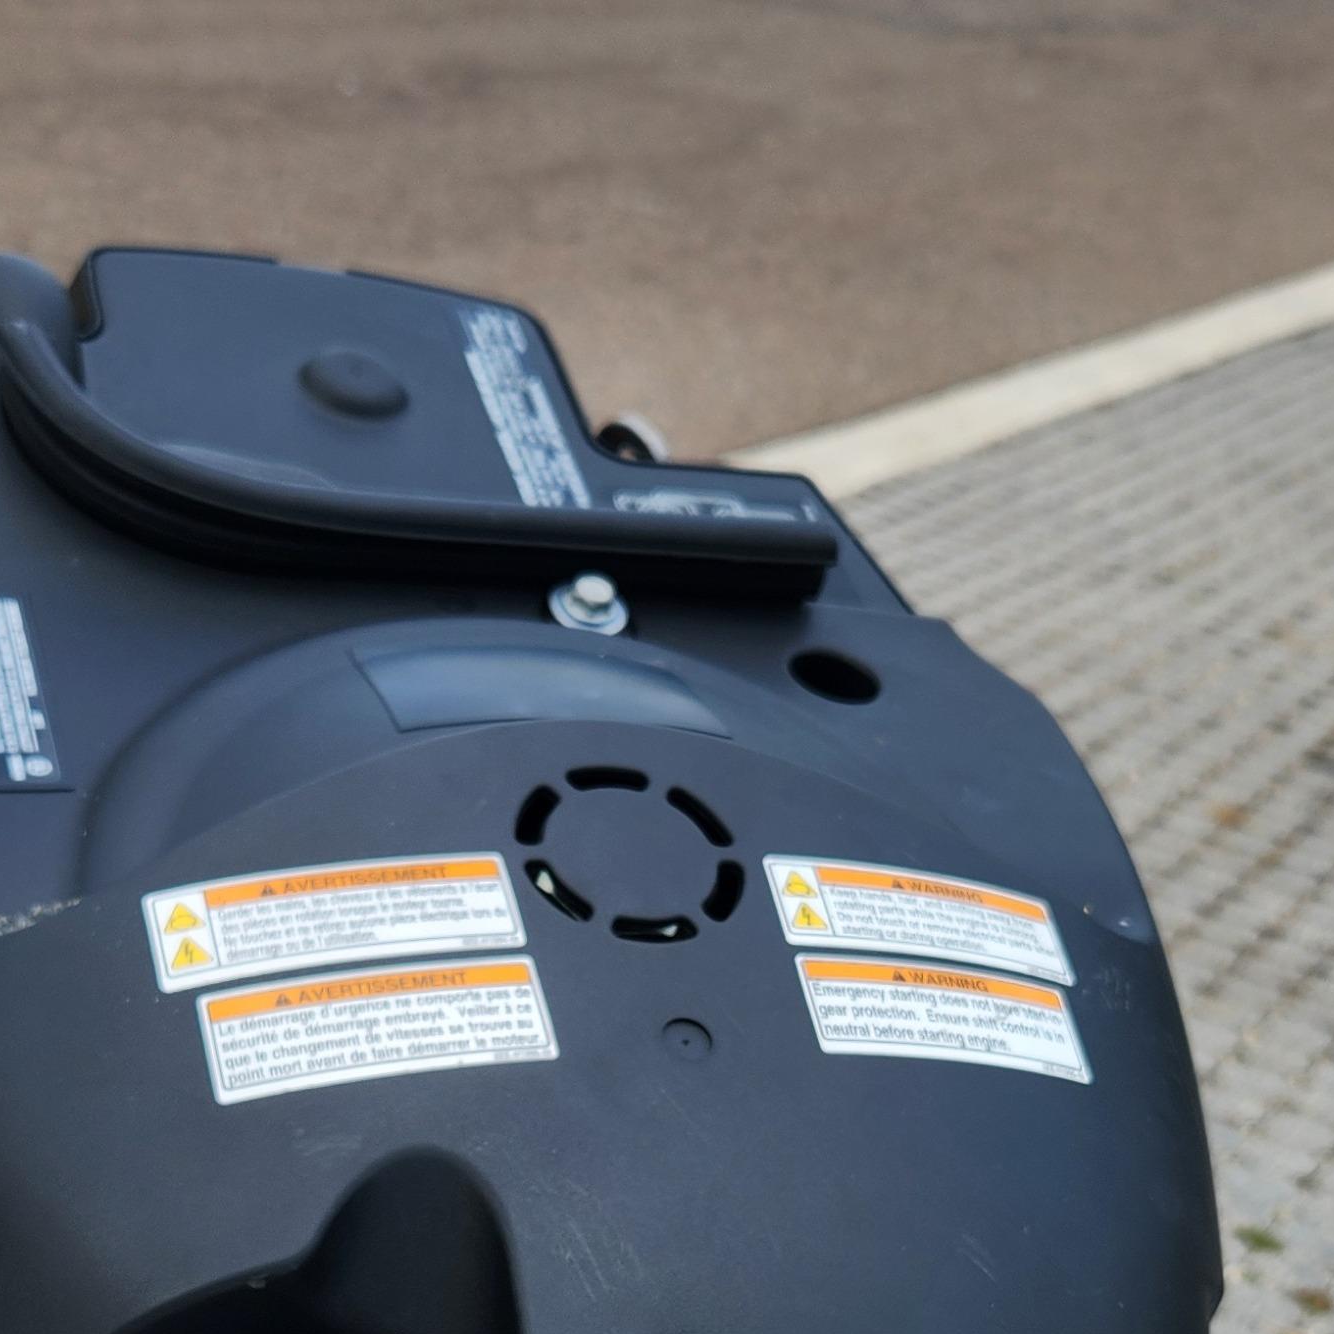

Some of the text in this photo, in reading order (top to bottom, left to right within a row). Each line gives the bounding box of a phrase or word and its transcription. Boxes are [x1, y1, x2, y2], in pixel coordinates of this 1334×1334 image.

[283, 864, 446, 894] AVERTISSEMENT
[906, 880, 984, 904] WARNING
[299, 973, 467, 1004] AVERTISSEMENT
[908, 970, 989, 993] WARNING
[219, 1021, 237, 1037] Le
[240, 1008, 316, 1033] démarrage
[395, 997, 411, 1009] ne
[417, 988, 482, 1007] comporte
[486, 989, 511, 1002] pas
[515, 986, 531, 999] de
[812, 982, 885, 1002] Emergency
[888, 987, 938, 1007] starting
[938, 992, 969, 1009] does
[970, 998, 992, 1012] not
[221, 1030, 279, 1051] sécurité
[283, 1026, 300, 1042] de
[305, 1015, 380, 1038] démarrage
[517, 1003, 532, 1014] ce
[818, 1004, 847, 1019] gear
[851, 1005, 921, 1022] protection.
[925, 1008, 969, 1026] Ensure
[972, 1014, 999, 1031] shift
[225, 1055, 251, 1070] que
[255, 1049, 268, 1063] le
[272, 1033, 361, 1060] changement
[365, 1030, 382, 1045] de
[386, 1024, 444, 1041] vitesses
[449, 1023, 464, 1035] se
[468, 1018, 513, 1033] trouve
[824, 1022, 871, 1038] neutral
[872, 1023, 915, 1040] before
[917, 1027, 967, 1050] starting
[228, 1064, 265, 1089] point
[269, 1057, 302, 1078] mort
[306, 1052, 346, 1071] avant
[350, 1047, 368, 1064] de
[371, 1043, 404, 1061] faire
[407, 1038, 470, 1055] démarrer
[475, 1035, 487, 1048] le
